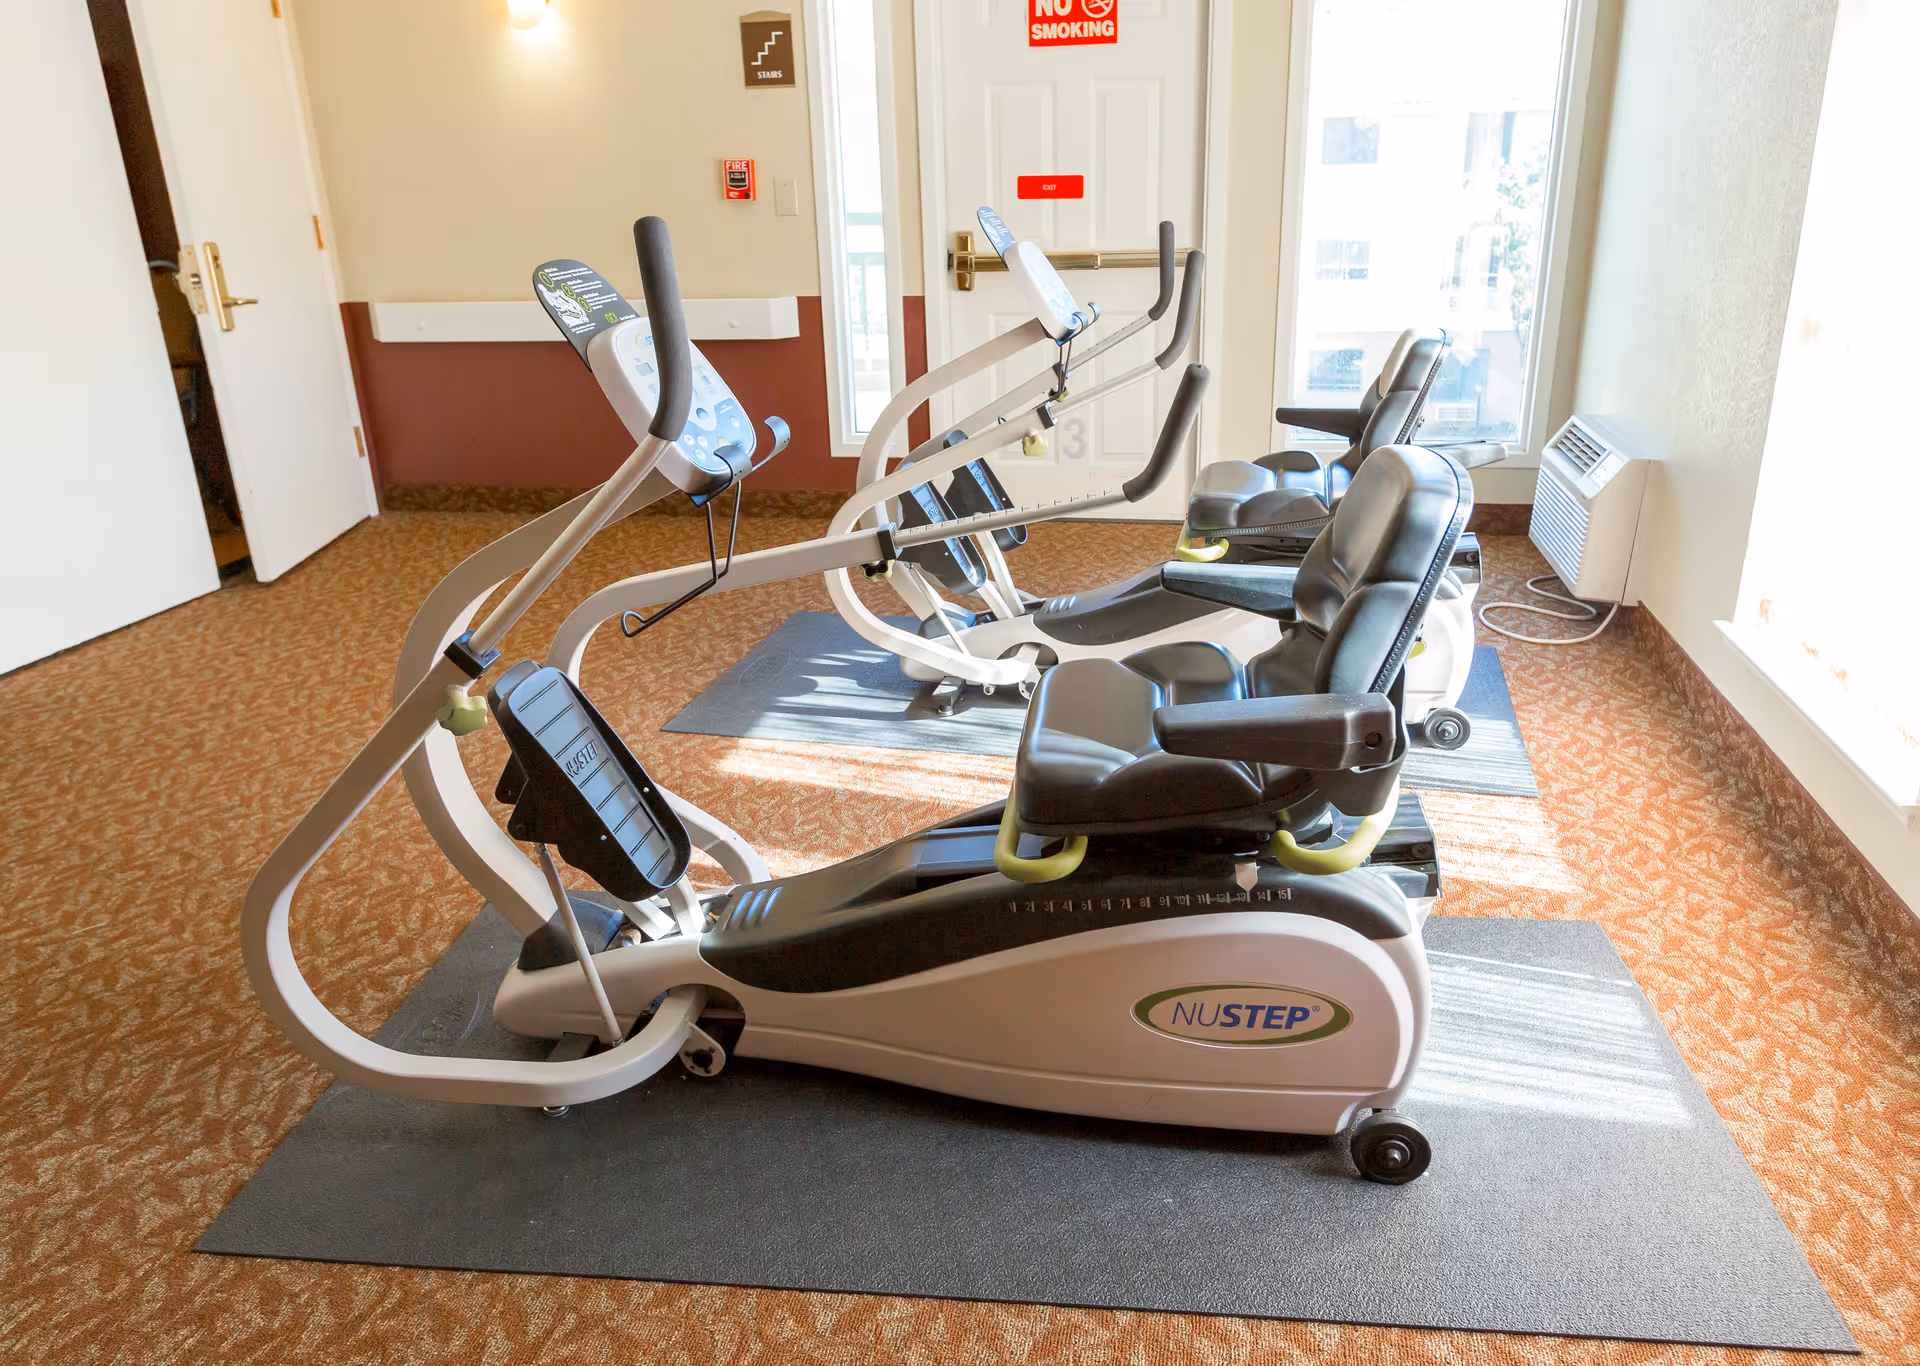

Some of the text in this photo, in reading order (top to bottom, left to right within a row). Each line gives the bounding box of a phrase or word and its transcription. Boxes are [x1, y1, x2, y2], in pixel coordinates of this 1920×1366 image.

[1035, 0, 1073, 17] NO
[1031, 20, 1115, 40] SMOKING
[757, 70, 783, 79] STAIRS
[726, 161, 748, 170] FIRE
[1063, 418, 1087, 460] 3
